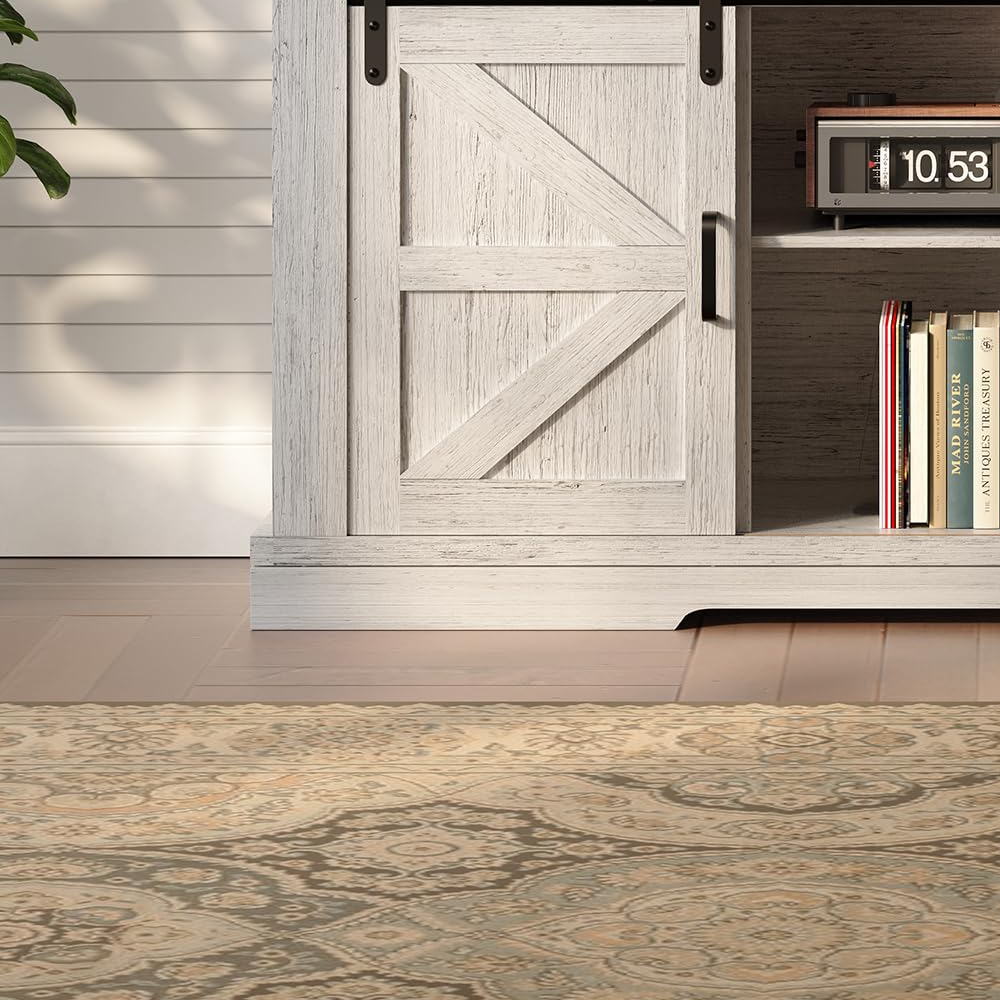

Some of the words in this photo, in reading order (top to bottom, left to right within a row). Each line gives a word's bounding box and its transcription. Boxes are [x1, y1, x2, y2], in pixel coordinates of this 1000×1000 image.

[947, 150, 989, 183] 53
[952, 372, 960, 428] RIVER
[982, 367, 990, 431] TREASURY
[952, 435, 960, 475] MAD
[982, 434, 991, 496] ANTIQUES
